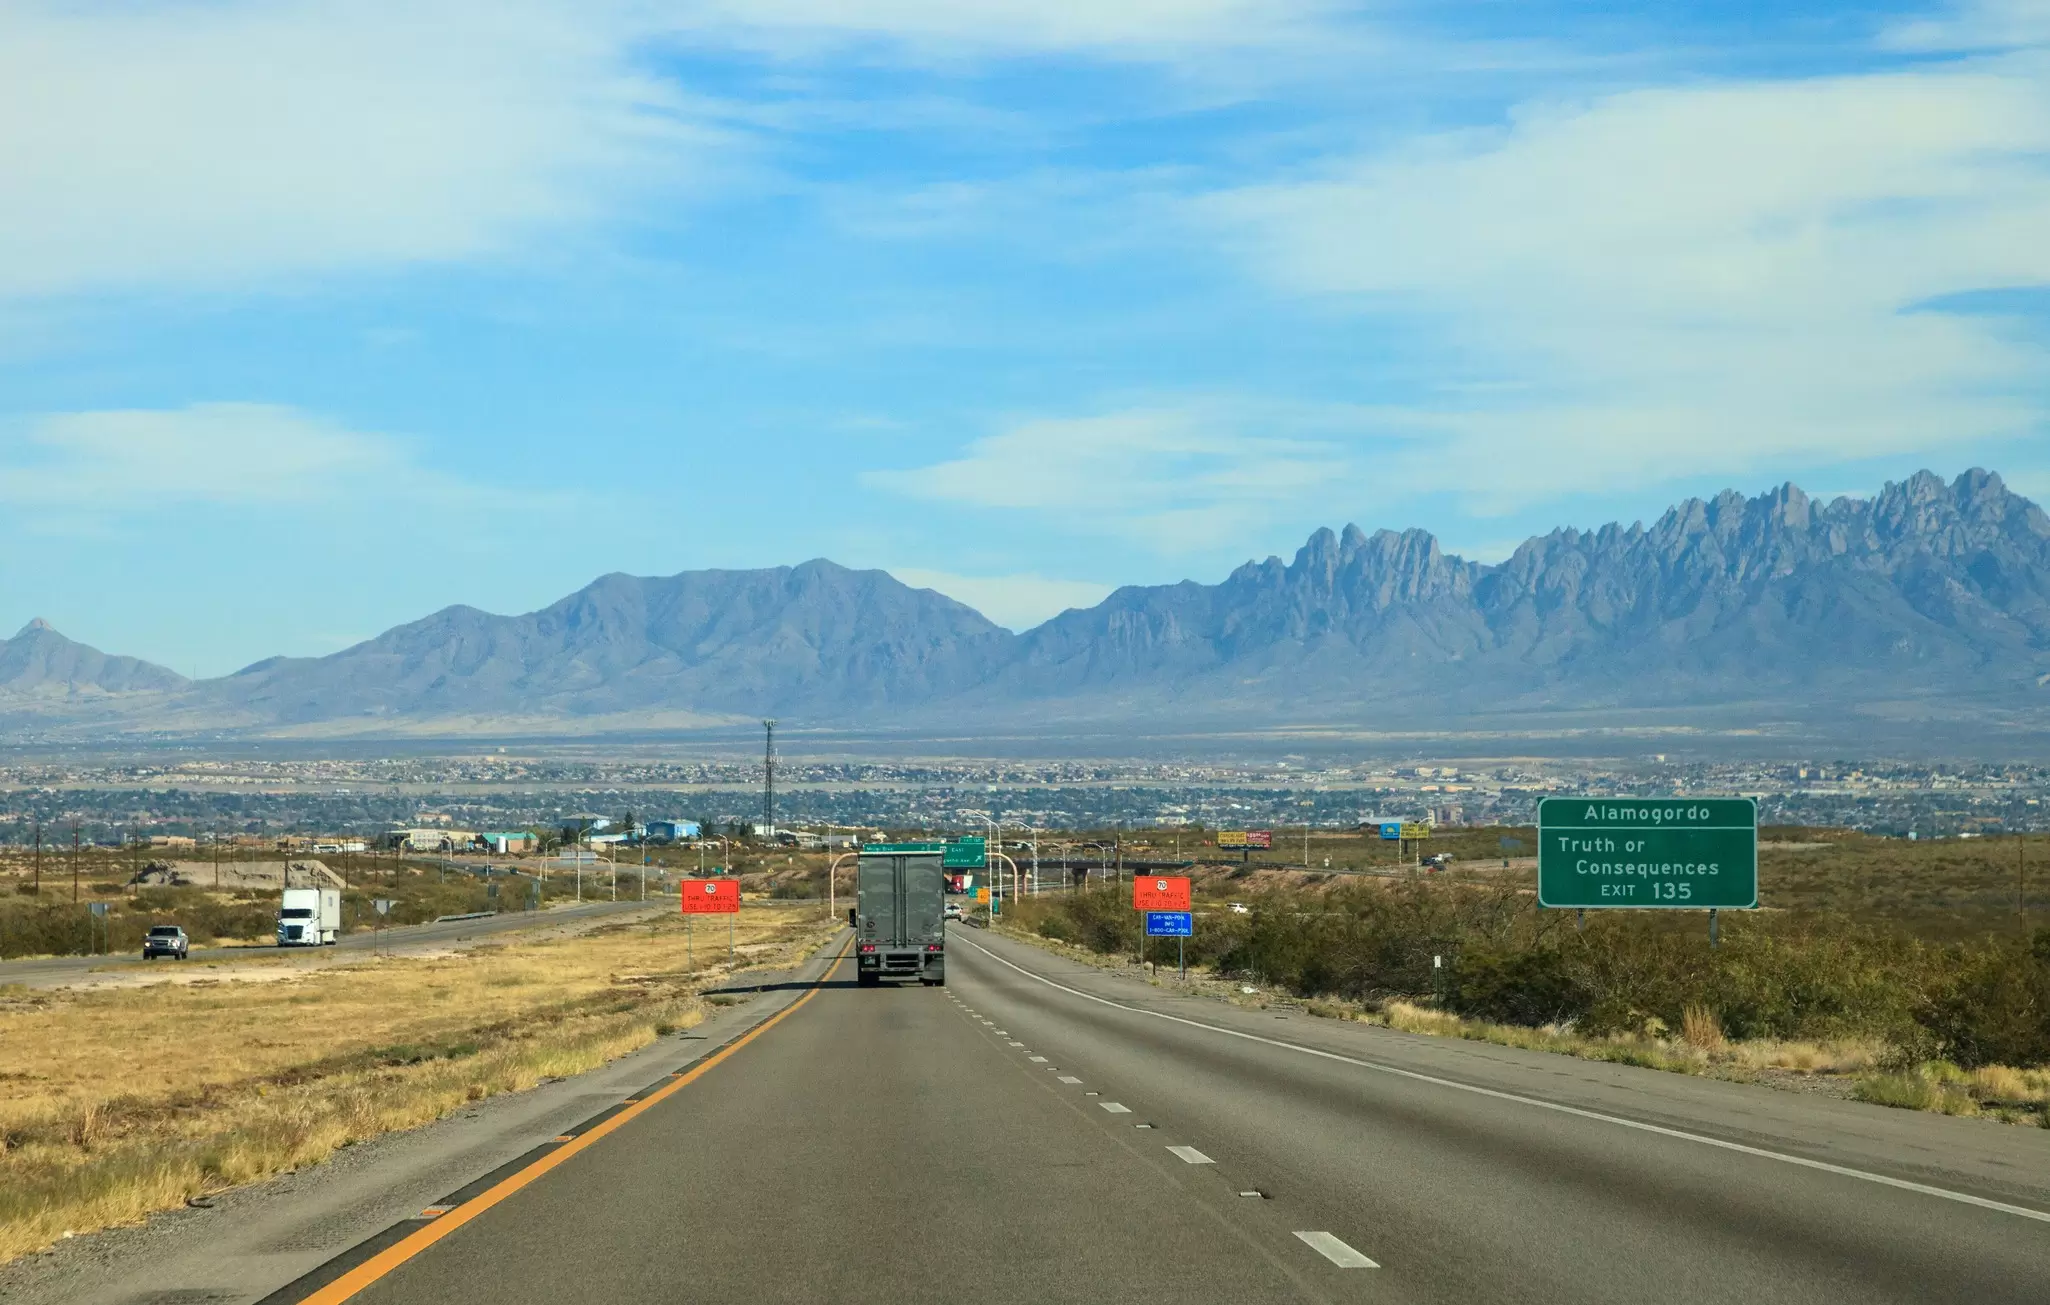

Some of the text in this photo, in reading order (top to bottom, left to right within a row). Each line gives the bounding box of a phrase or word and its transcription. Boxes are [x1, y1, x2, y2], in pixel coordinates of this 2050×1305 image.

[1584, 804, 1710, 824] Alamogordo
[1558, 837, 1645, 852] Truth or
[1576, 859, 1719, 879] Consequences
[1601, 882, 1692, 899] EXIT 135
